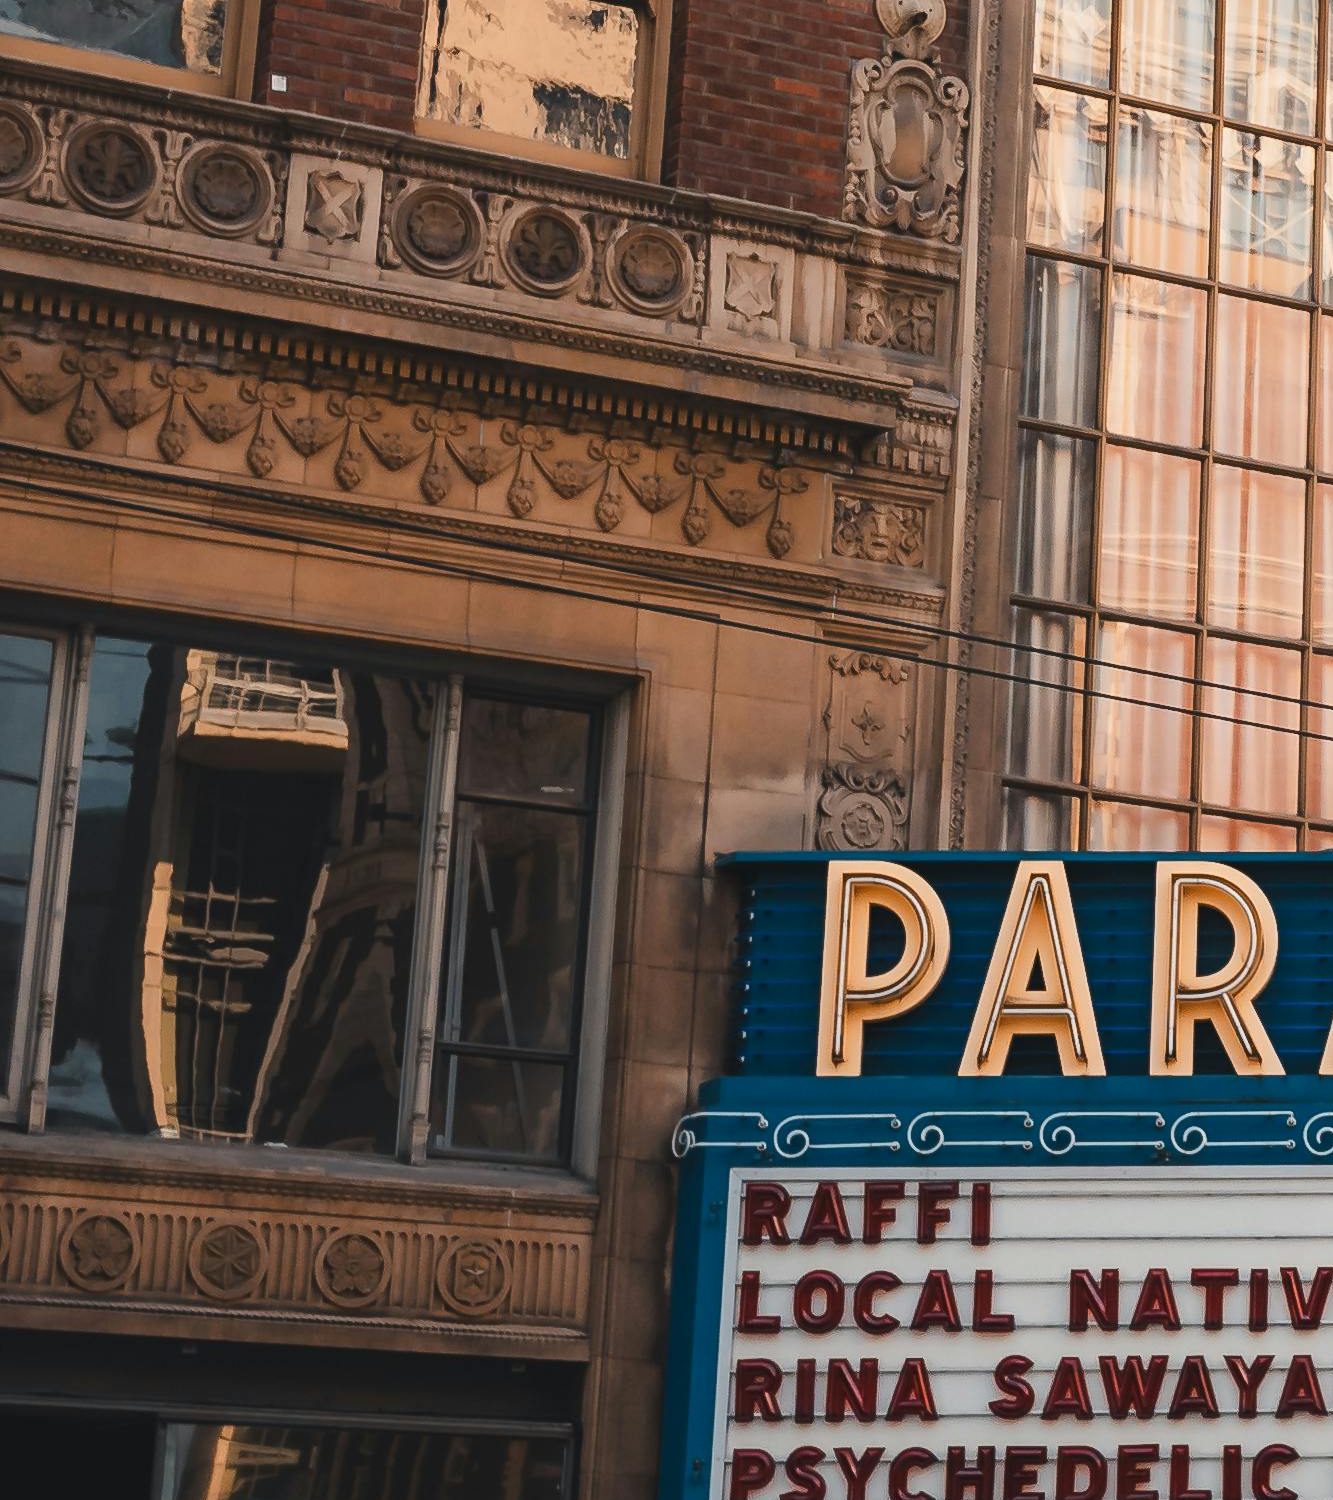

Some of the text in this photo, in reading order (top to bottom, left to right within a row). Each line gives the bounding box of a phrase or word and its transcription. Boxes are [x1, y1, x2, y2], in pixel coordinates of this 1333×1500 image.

[742, 1181, 993, 1249] RAFFI
[738, 1269, 1016, 1338] LOCAL
[734, 1356, 939, 1428] RINA
